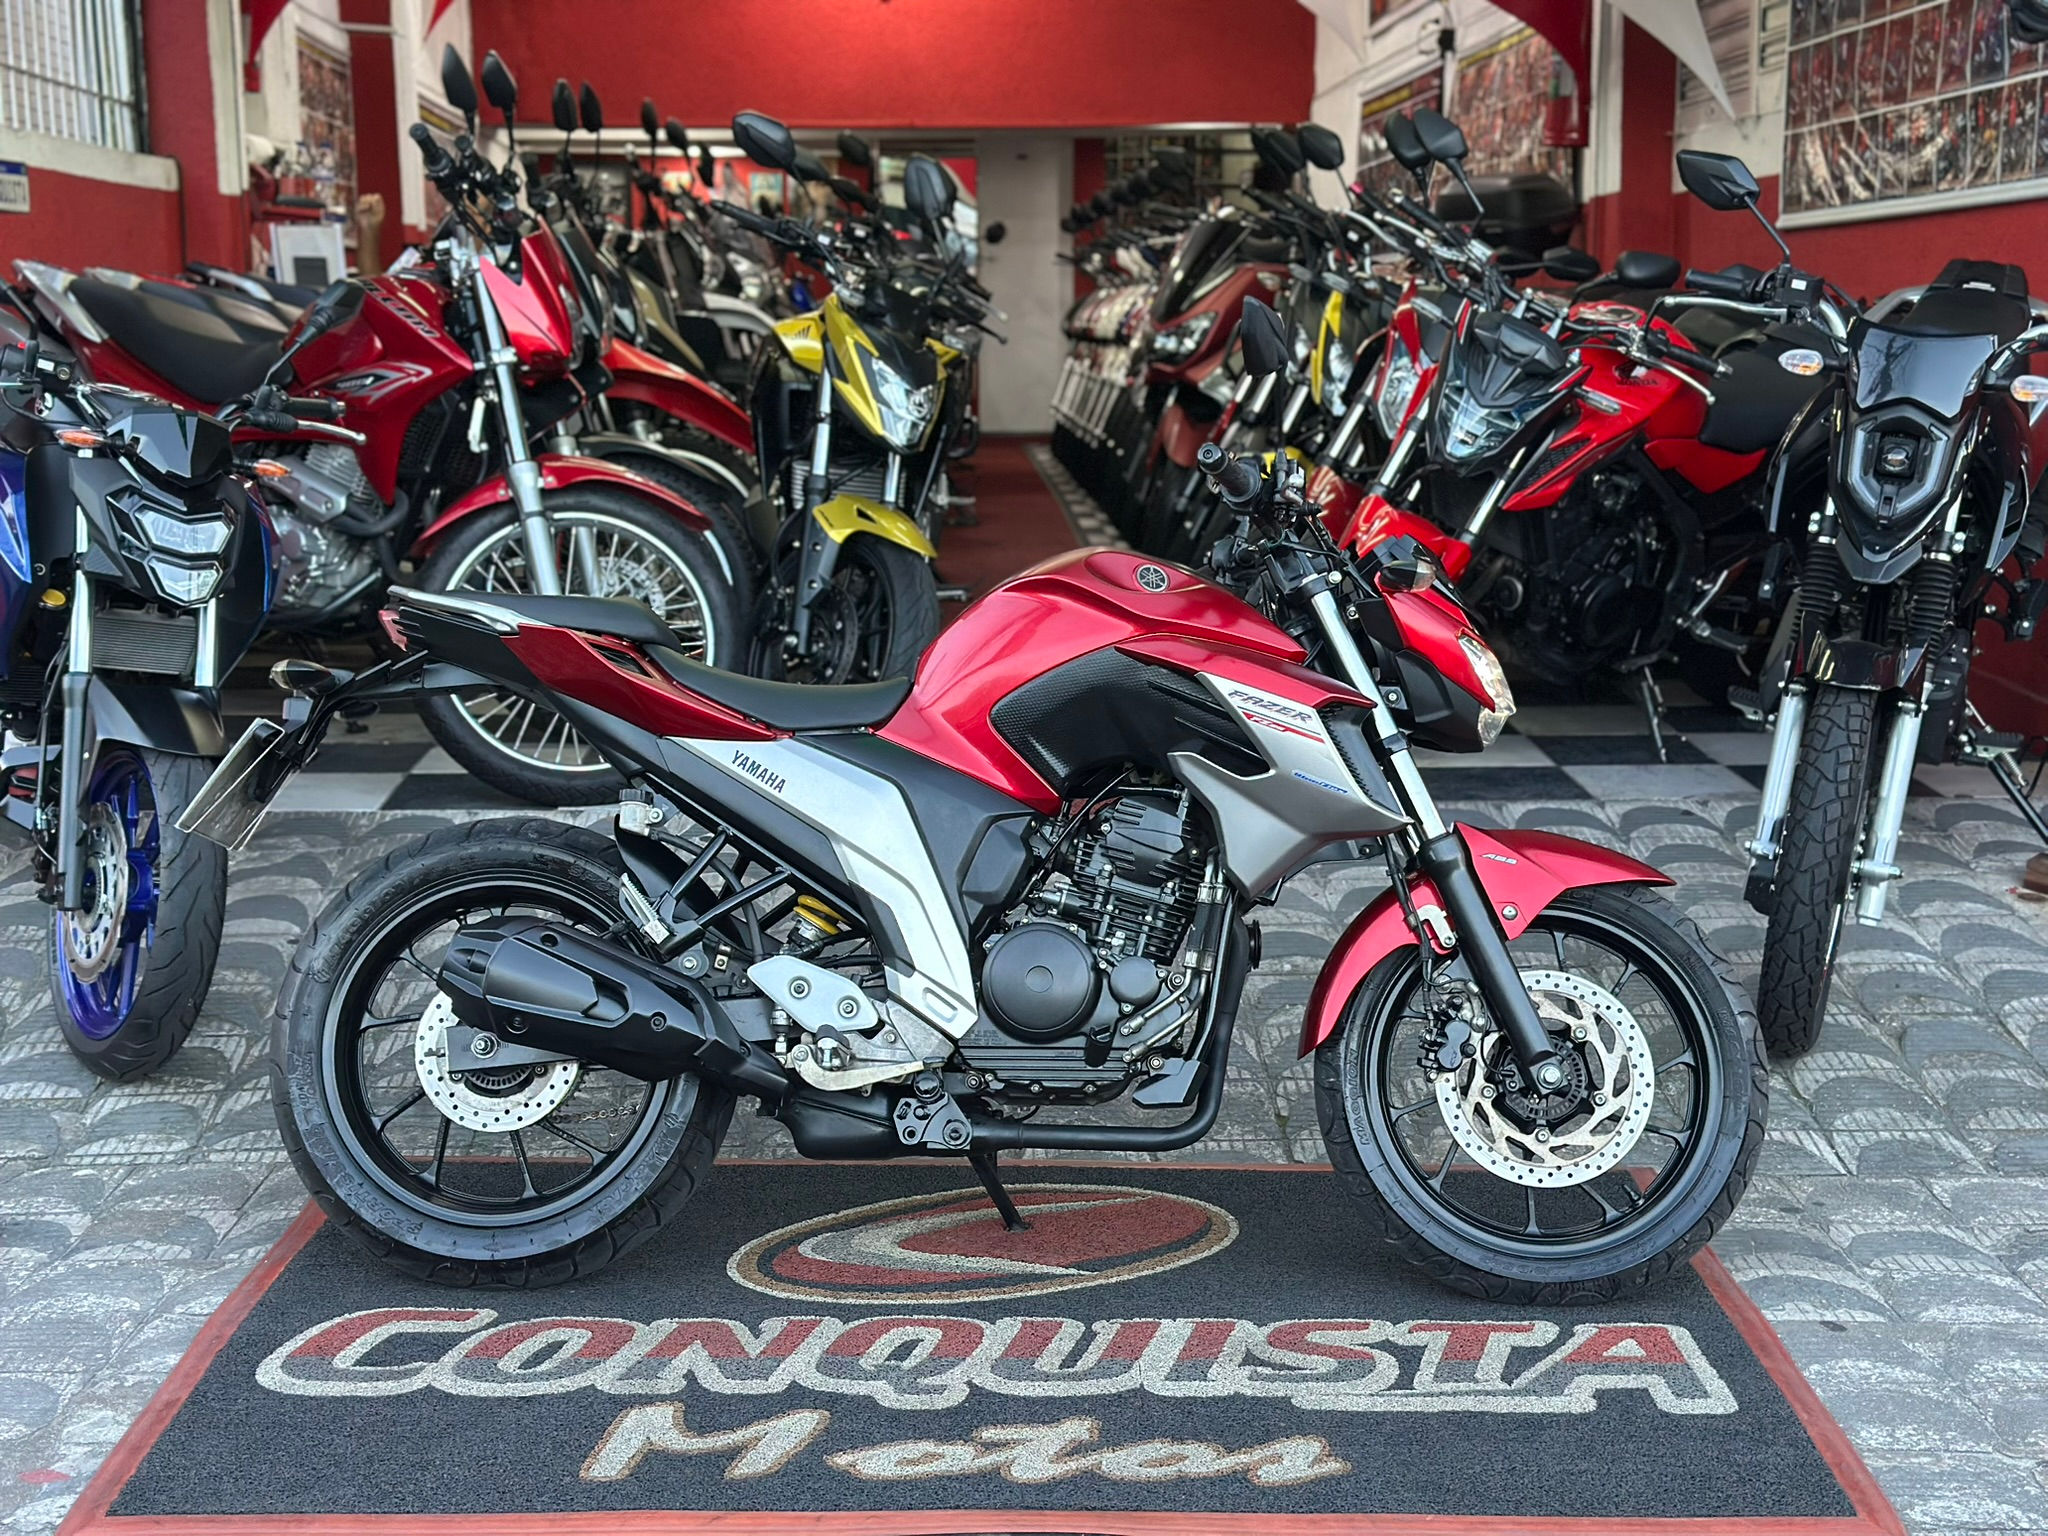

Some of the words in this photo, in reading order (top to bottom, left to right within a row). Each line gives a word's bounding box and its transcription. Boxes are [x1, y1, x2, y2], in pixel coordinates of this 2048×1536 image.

[1228, 690, 1313, 723] FAZER
[732, 750, 786, 793] YAMAHA
[1480, 853, 1518, 865] ABS
[255, 1306, 1740, 1416] CONQUISTA
[579, 1400, 1352, 1487] Motos
